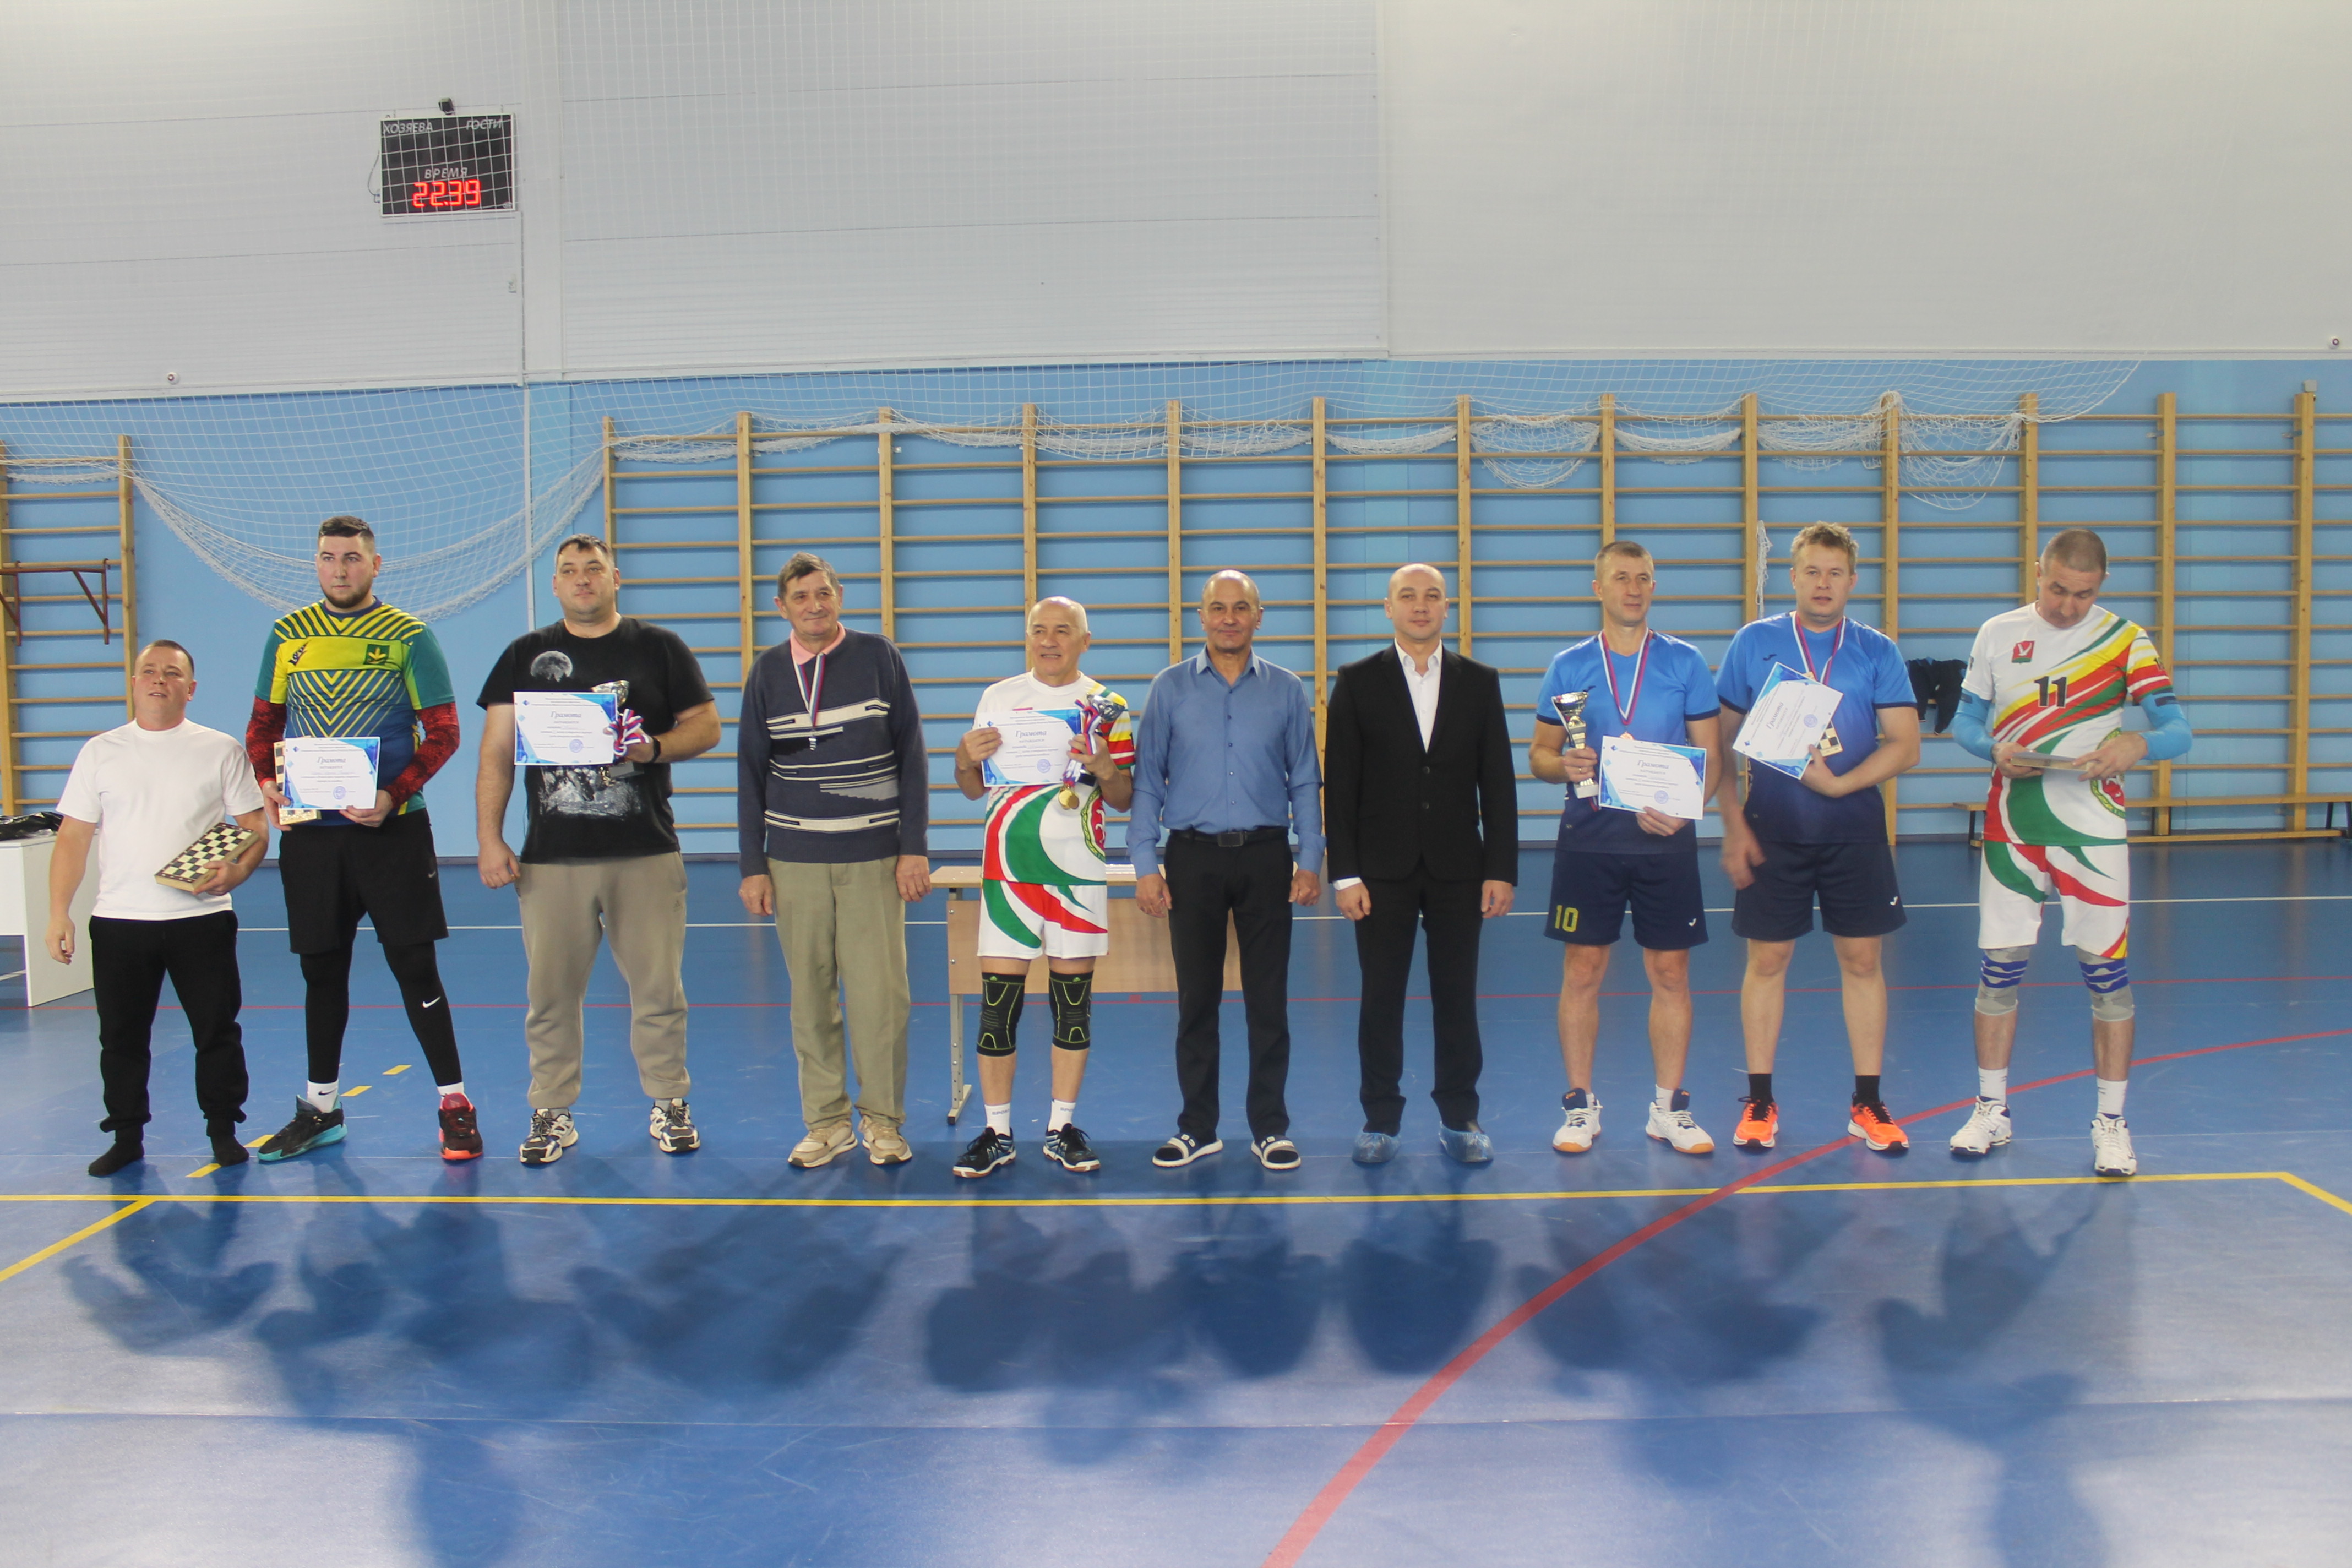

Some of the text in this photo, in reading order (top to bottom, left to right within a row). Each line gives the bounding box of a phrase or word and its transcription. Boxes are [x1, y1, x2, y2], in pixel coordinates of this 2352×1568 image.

[383, 122, 433, 134] ХОЗЯЕВА
[466, 118, 503, 130] ГОСТИ
[424, 167, 467, 179] ВРЕМЯ
[2034, 676, 2067, 709] 11
[551, 711, 582, 719] Грамота
[1766, 701, 1784, 729] Грамота
[1015, 730, 1047, 738] Грамота
[317, 756, 346, 765] Грамота
[1637, 760, 1669, 769] Грамота
[1555, 905, 1579, 933] 10
